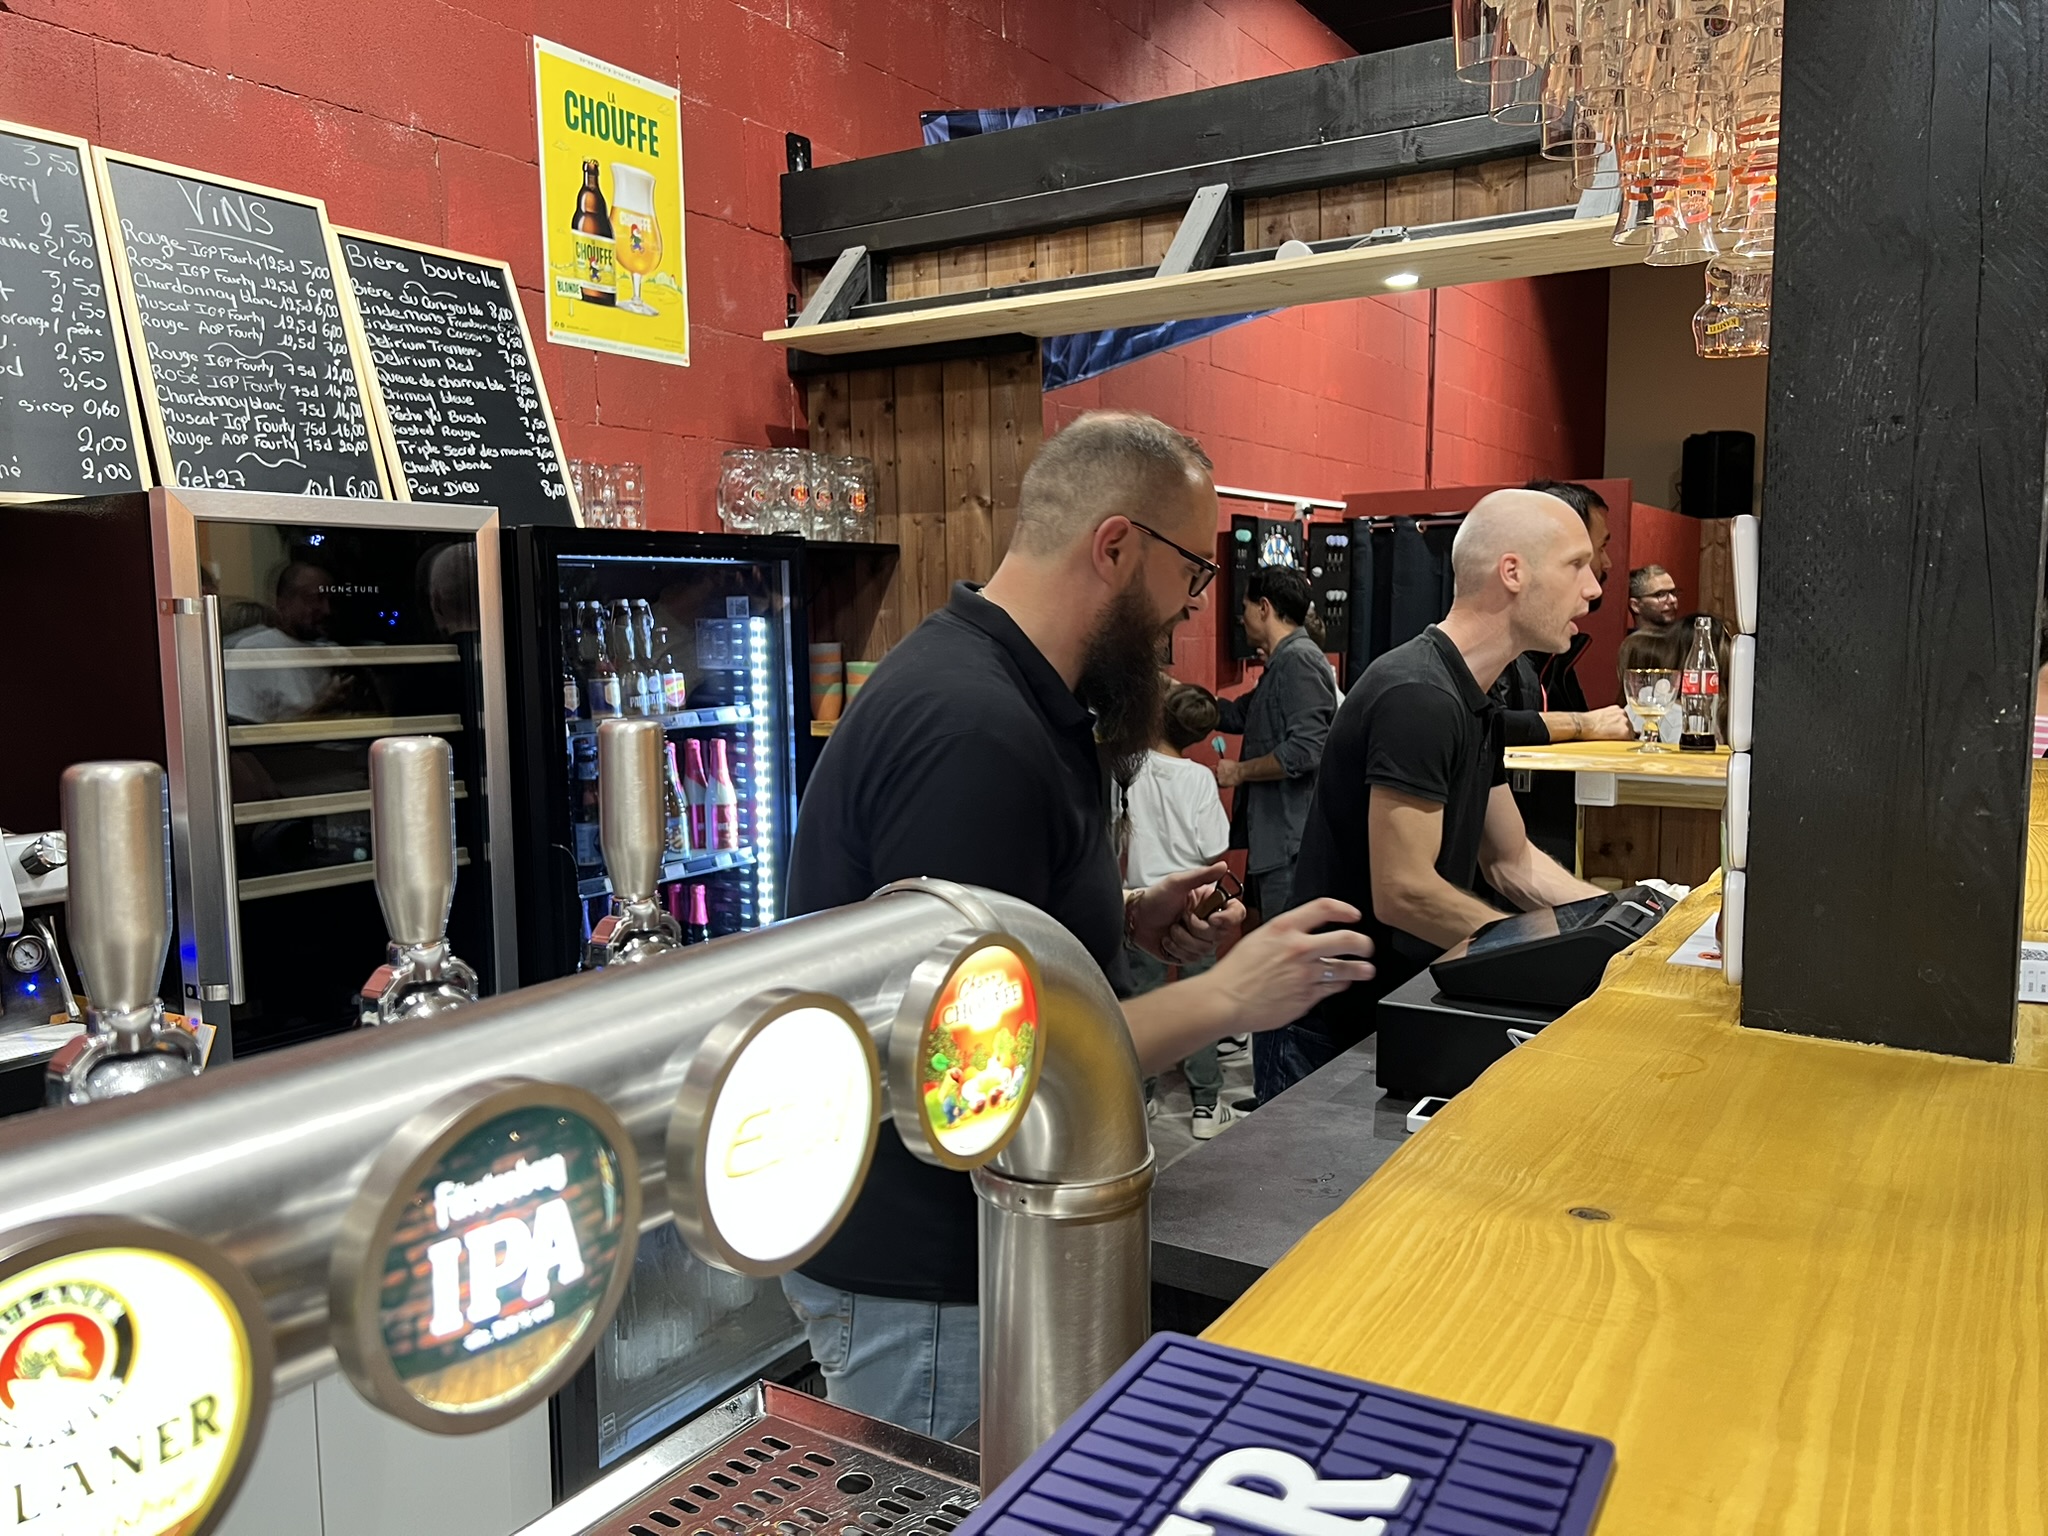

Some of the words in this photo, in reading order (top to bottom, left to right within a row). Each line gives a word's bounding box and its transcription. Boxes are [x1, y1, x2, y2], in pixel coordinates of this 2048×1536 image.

[607, 91, 617, 105] LA
[564, 90, 660, 158] CHOUFFE
[12, 142, 79, 176] 3,50
[39, 212, 93, 248] 2,50
[121, 218, 186, 258] Rouge
[187, 240, 217, 259] IGP
[300, 260, 330, 280] 5,00
[575, 241, 614, 266] CHOUFFE
[346, 244, 409, 272] Bière
[420, 256, 501, 289] bouteille
[134, 272, 238, 308] Chardonnay
[176, 262, 210, 279] IGP
[305, 281, 334, 305] 6,00
[556, 280, 581, 296] BLONDE
[135, 292, 191, 312] Muscat
[194, 303, 225, 317] IGP
[399, 289, 418, 306] du
[140, 312, 189, 335] Rouge
[199, 320, 224, 335] AOP
[54, 342, 105, 364] 2,50
[147, 341, 199, 367] Rouge
[203, 354, 233, 367] IGP
[371, 349, 442, 369] Delirium
[445, 357, 474, 373] Red
[58, 367, 107, 391] 3,50
[206, 374, 239, 389] IGP
[83, 399, 120, 419] 0,60
[160, 405, 219, 426] Muscat
[221, 413, 249, 432] IGP
[77, 426, 127, 456] 2,00
[165, 425, 213, 454] Rouge
[221, 432, 249, 445] AOP
[81, 457, 132, 484] 2,00
[318, 583, 380, 596] SIGNATURE
[427, 1198, 584, 1336] IPA
